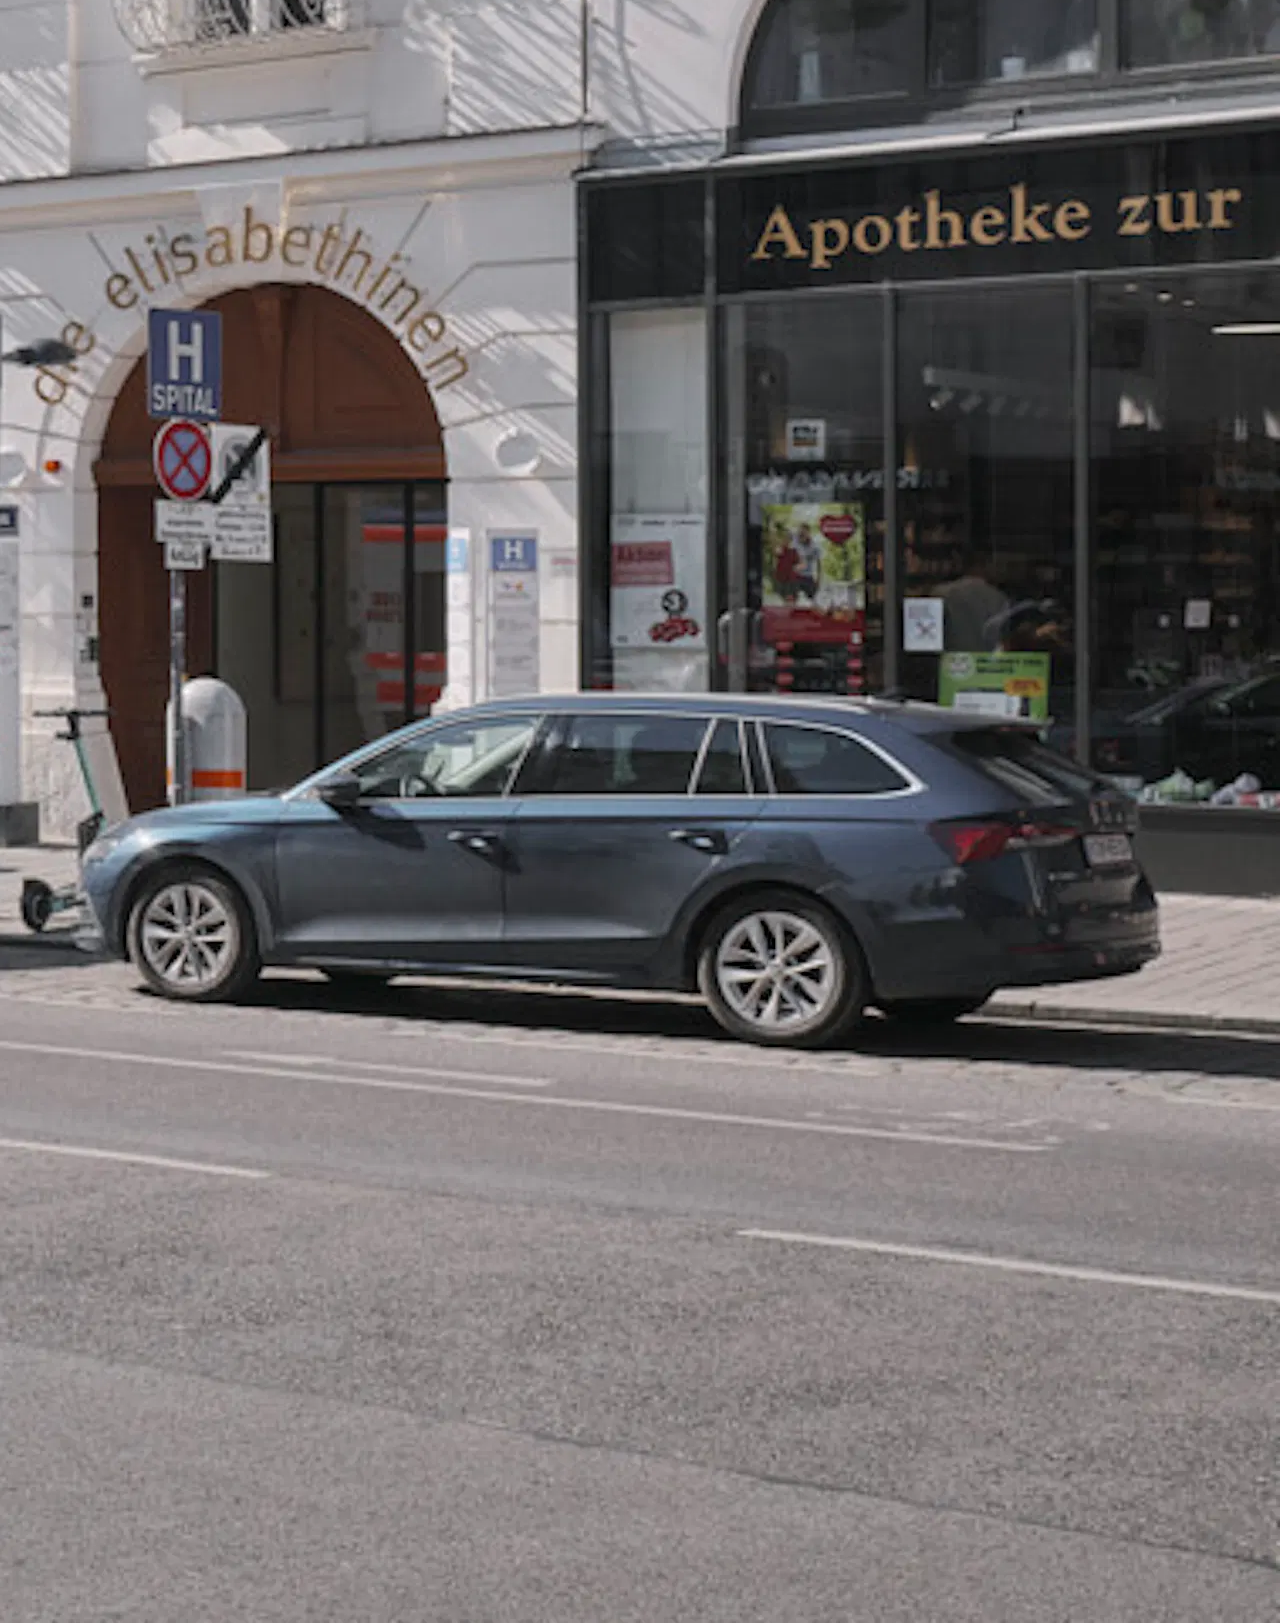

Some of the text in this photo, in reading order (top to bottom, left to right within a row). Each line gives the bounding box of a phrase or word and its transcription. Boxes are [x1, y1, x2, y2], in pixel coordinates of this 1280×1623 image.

[751, 182, 1242, 271] Apotheke zur
[34, 204, 471, 405] de elisabethinen
[167, 319, 205, 384] H
[152, 383, 218, 416] SPITAL
[504, 540, 524, 560] H
